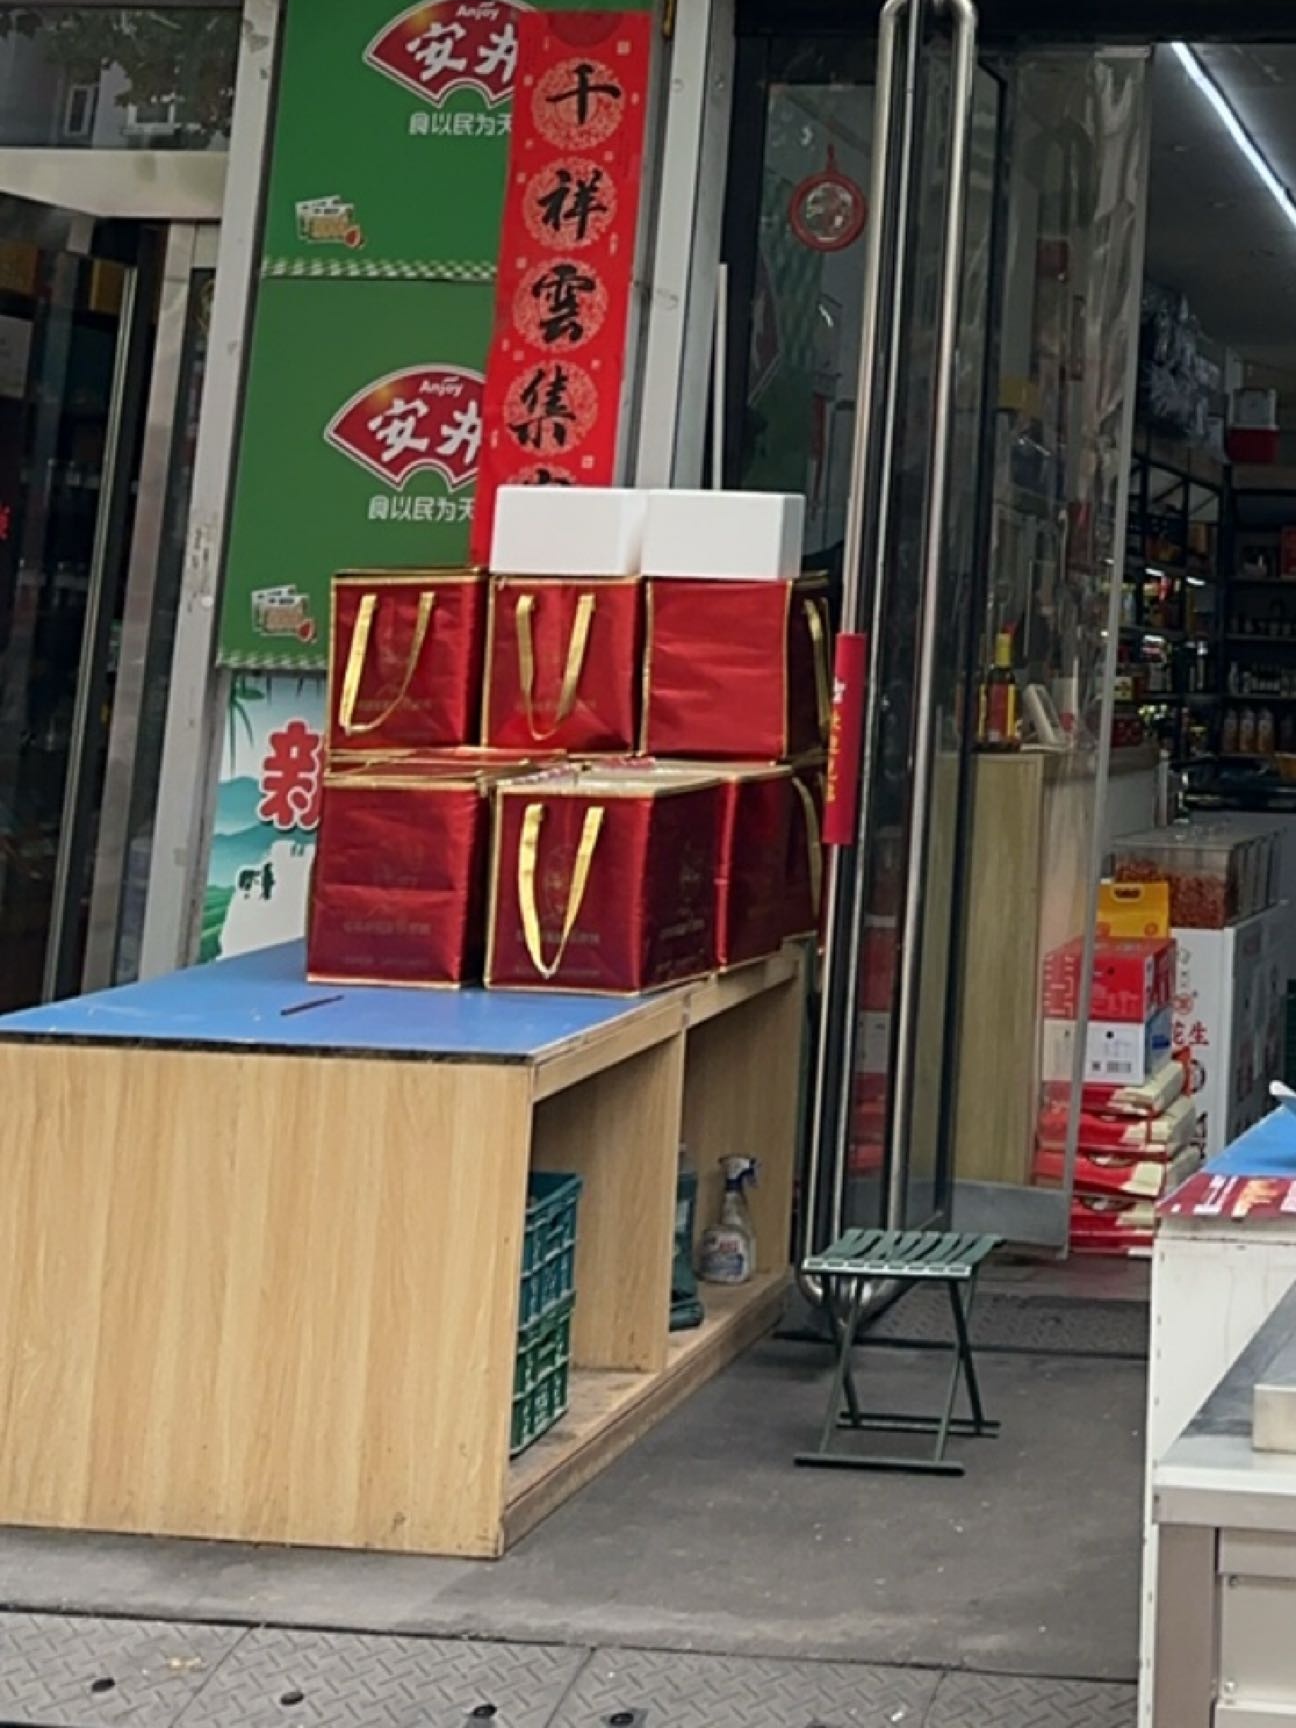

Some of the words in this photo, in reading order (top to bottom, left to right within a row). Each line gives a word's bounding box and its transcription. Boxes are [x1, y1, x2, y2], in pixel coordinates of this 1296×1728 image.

[456, 1, 500, 20] Anjoy
[508, 63, 622, 485] 千祥雲集
[419, 376, 463, 398] Anjoy
